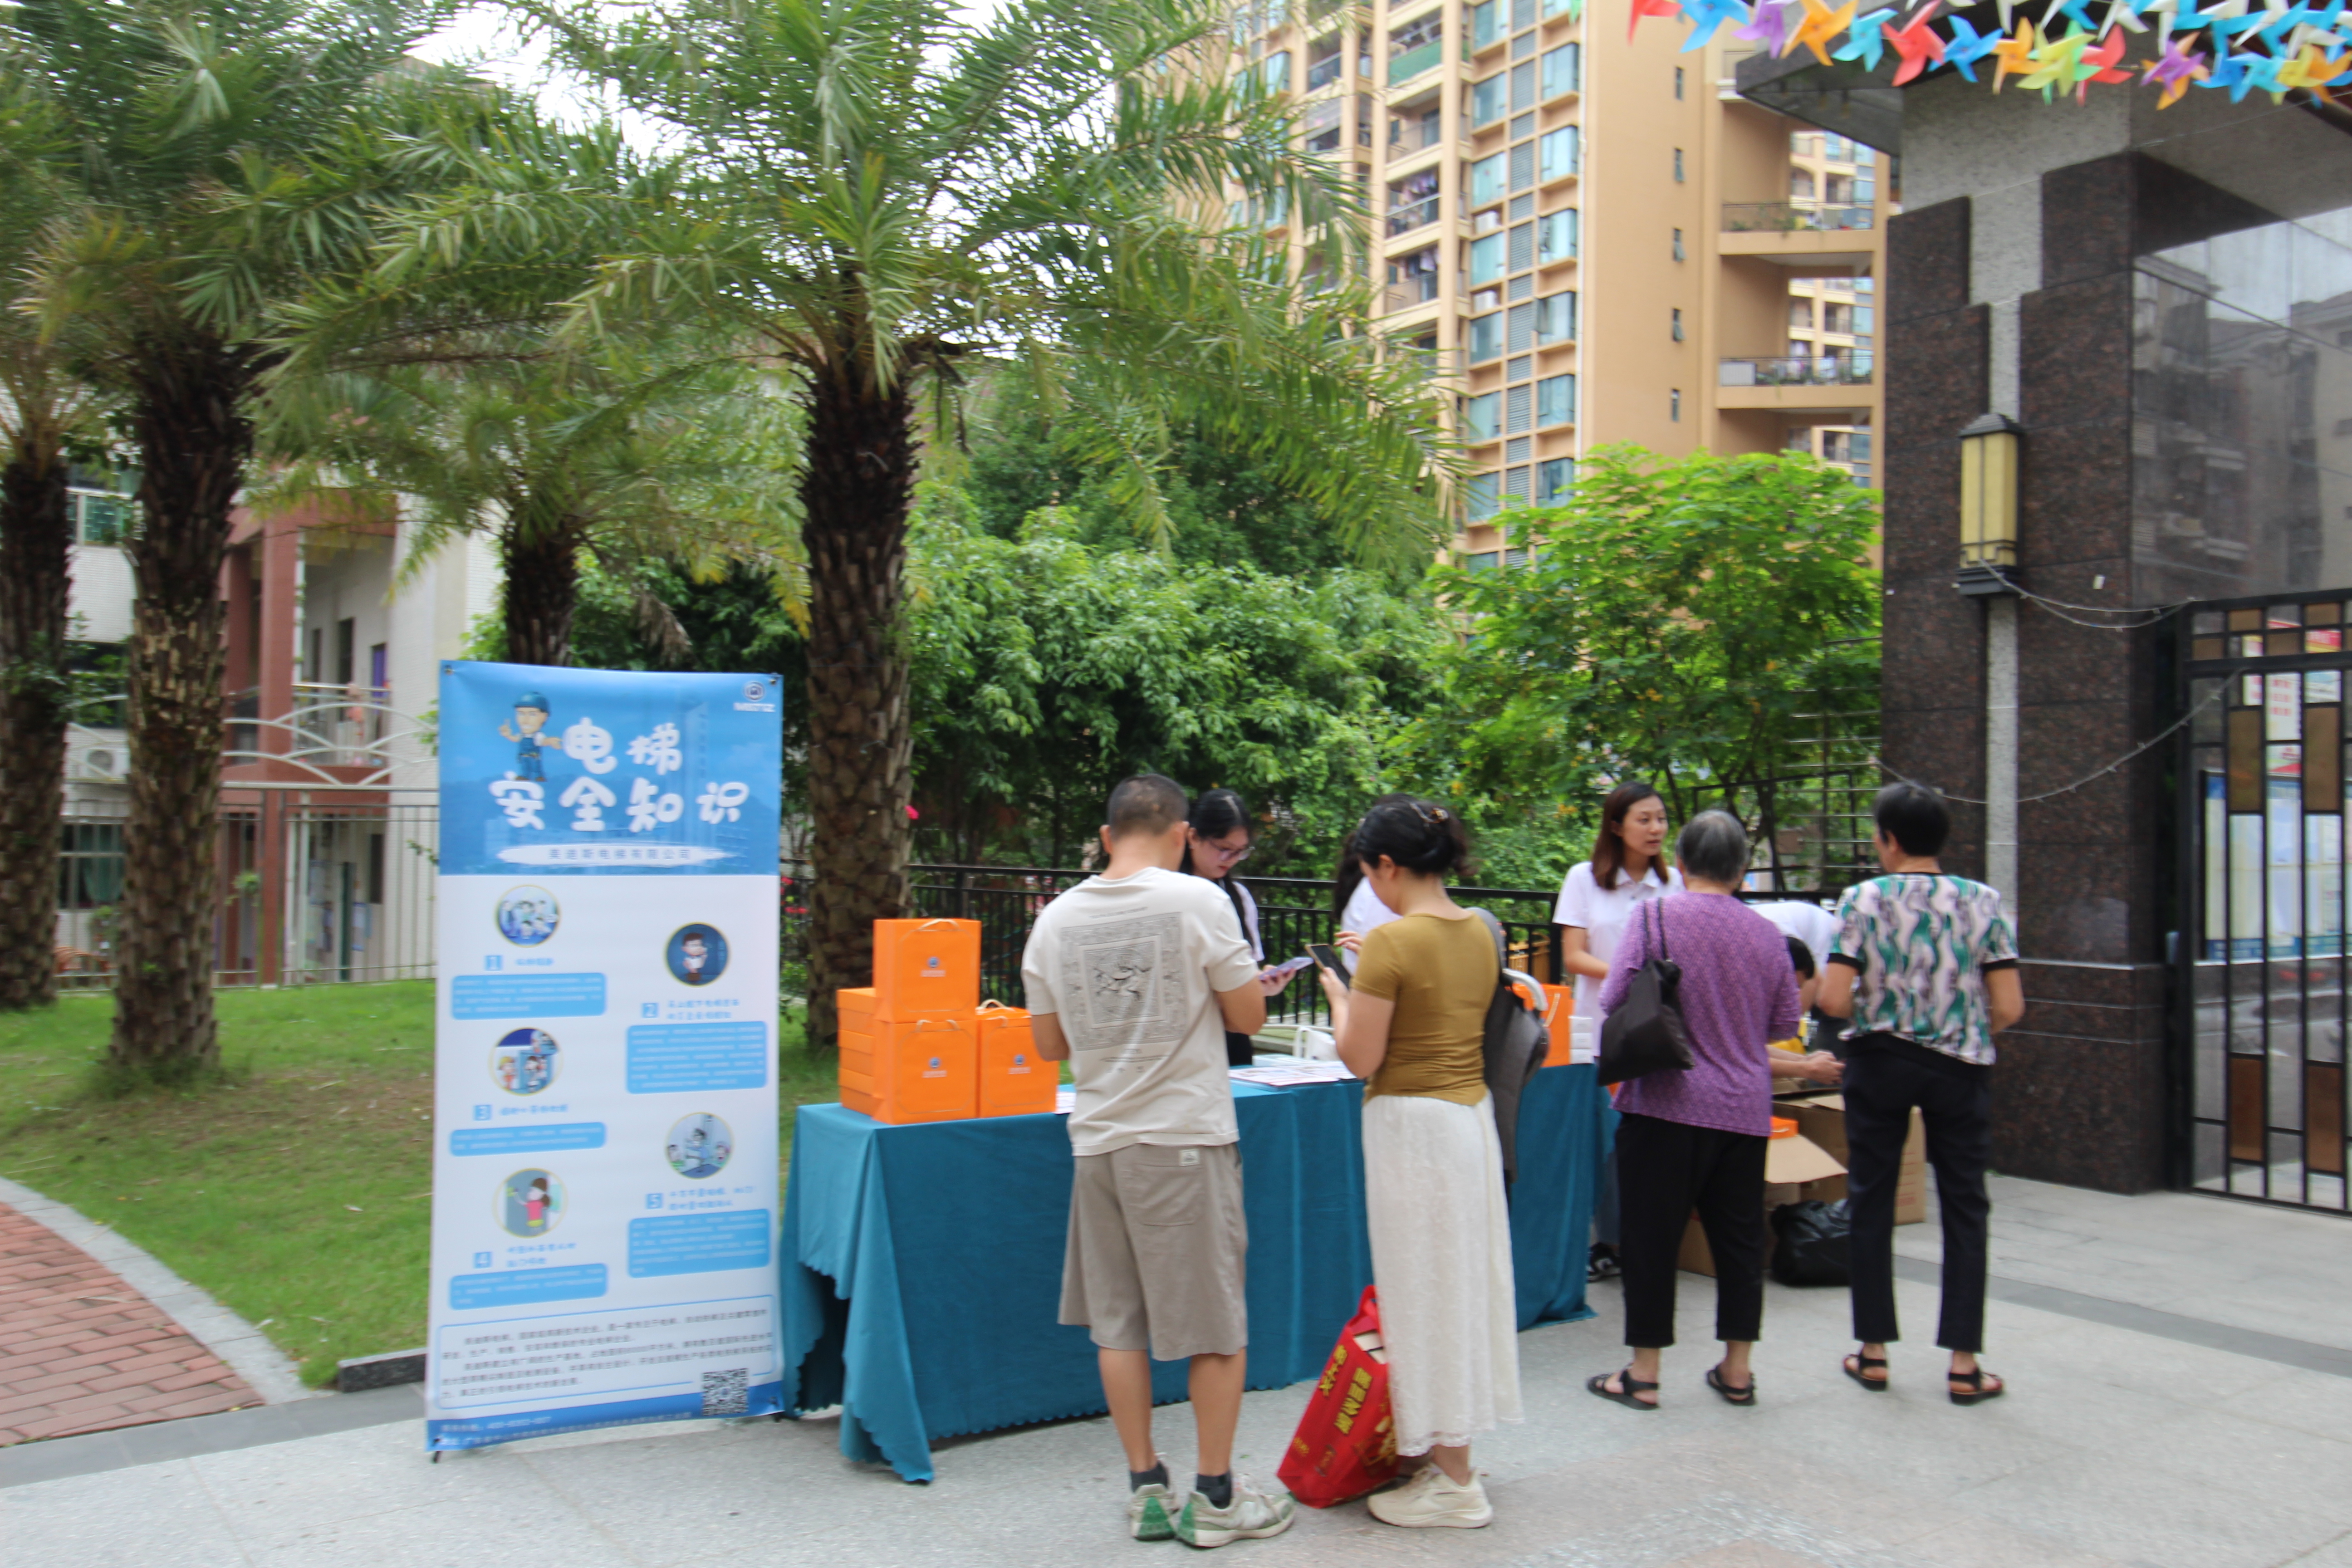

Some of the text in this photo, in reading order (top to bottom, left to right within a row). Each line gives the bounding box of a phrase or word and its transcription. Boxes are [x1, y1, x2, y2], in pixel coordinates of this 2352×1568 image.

[563, 716, 683, 775] 电梯
[488, 770, 750, 833] 安全知识
